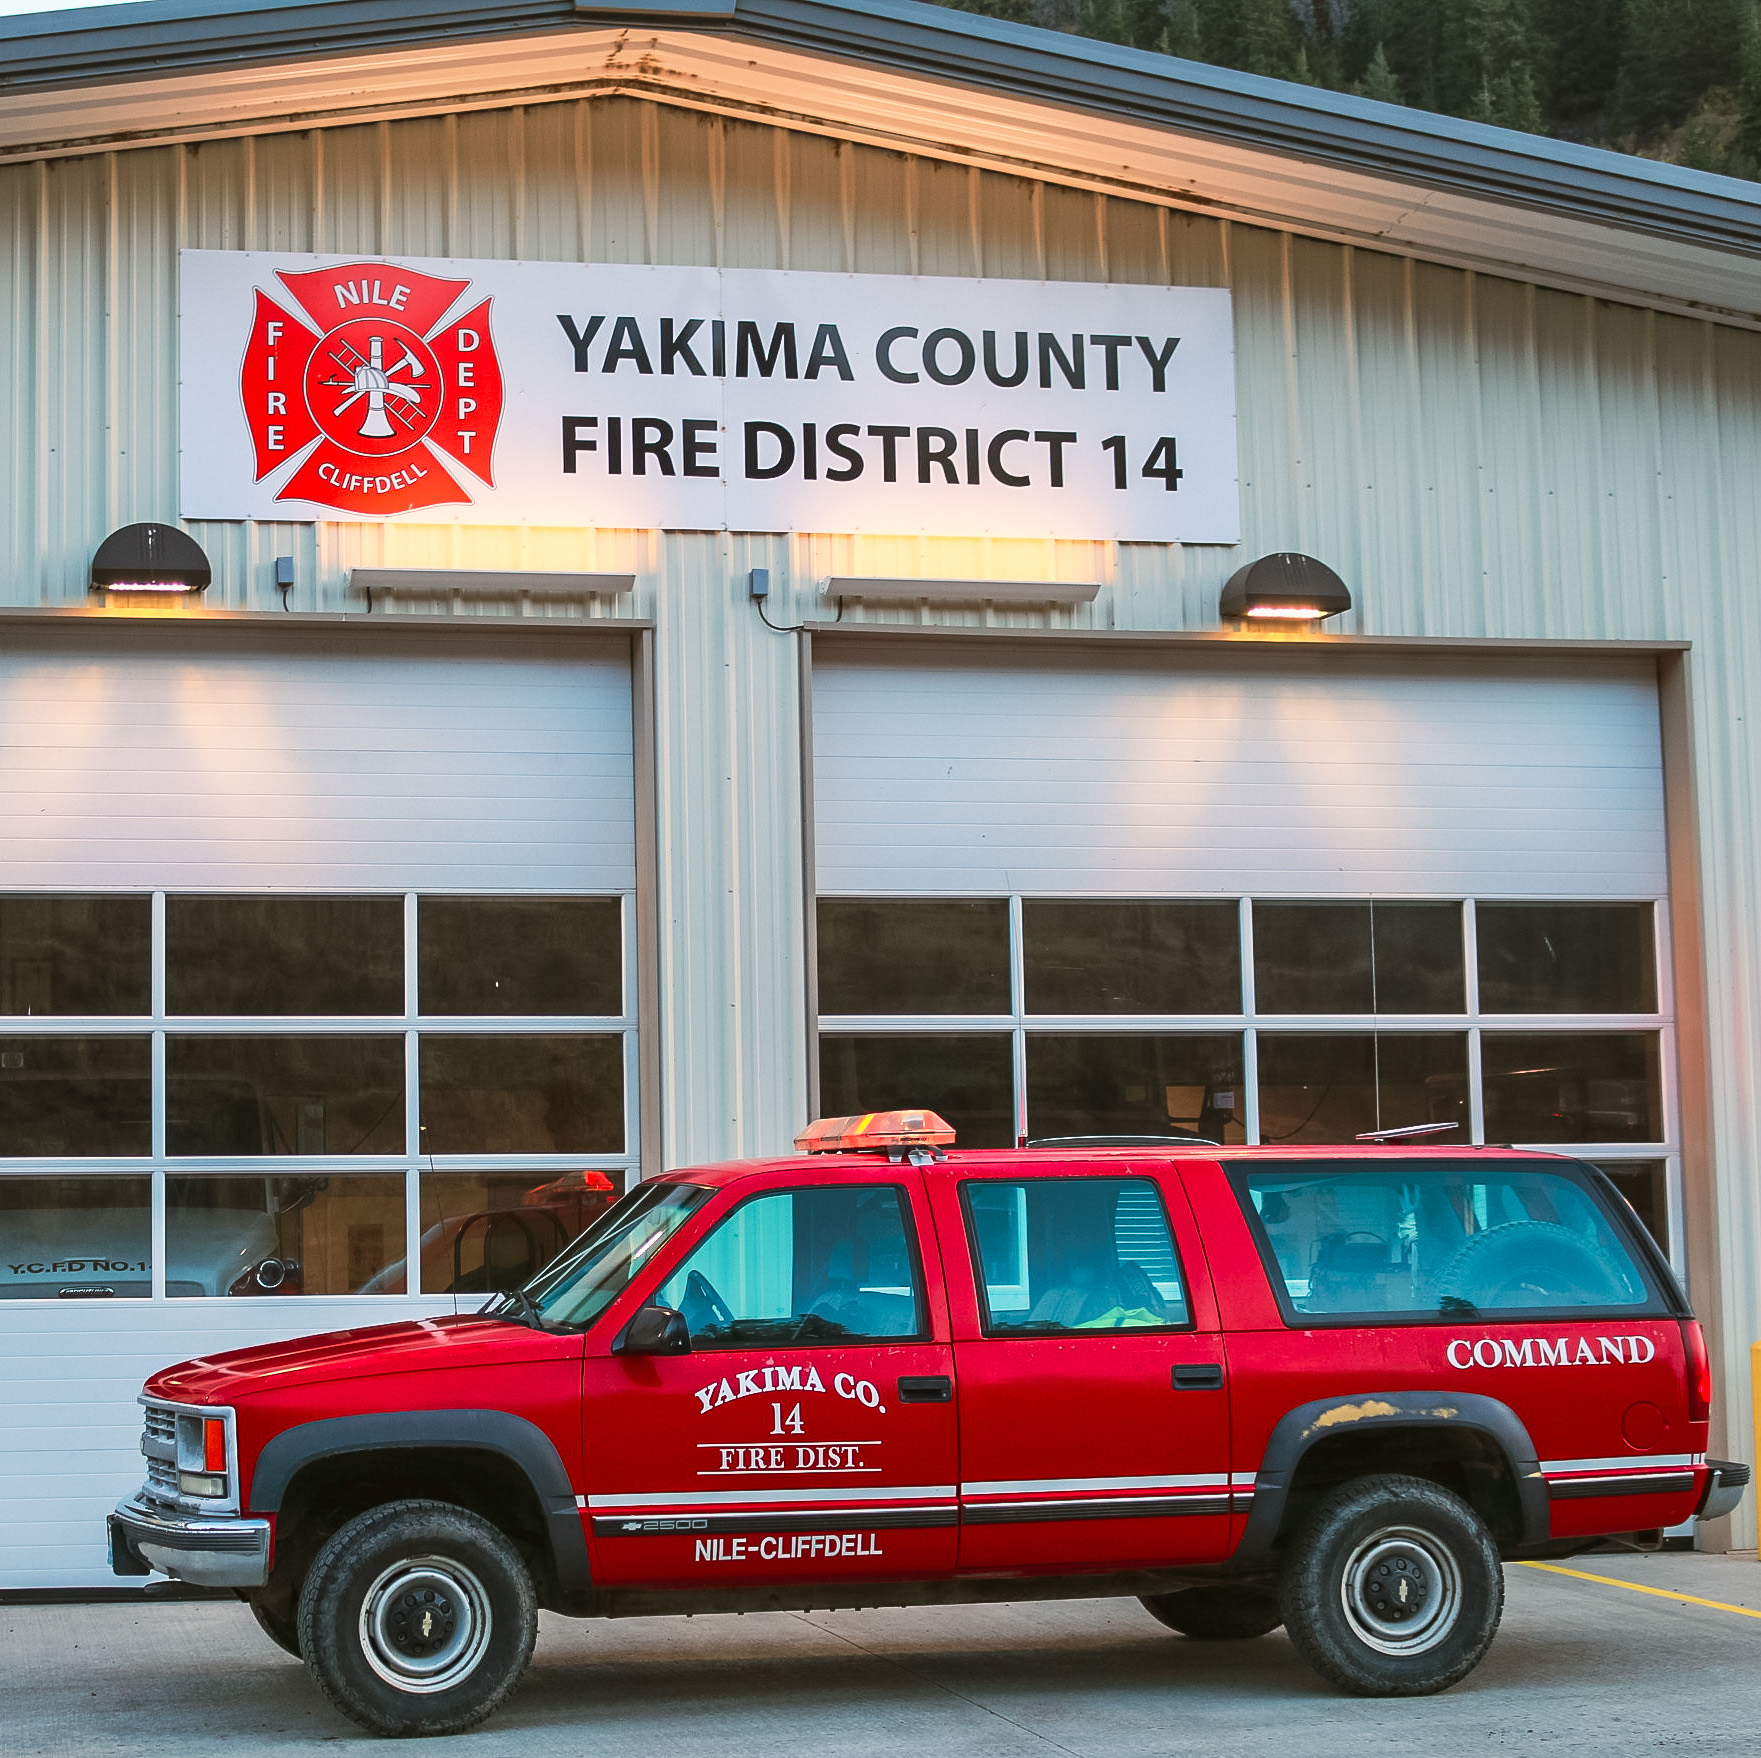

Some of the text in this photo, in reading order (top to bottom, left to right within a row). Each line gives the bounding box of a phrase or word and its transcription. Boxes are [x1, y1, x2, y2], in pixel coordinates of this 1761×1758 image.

[333, 279, 411, 311] NILE
[556, 314, 1181, 393] YAKIMA COUNTY
[266, 321, 287, 450] FIRE
[457, 328, 481, 454] DEPT
[562, 416, 1184, 492] FIRE DISTRICT 14
[317, 462, 428, 494] CLIFFDELL
[93, 1261, 152, 1272] NO.1
[1446, 1335, 1656, 1369] COMMAND
[694, 1366, 887, 1415] YAKIMA CO.
[770, 1402, 805, 1435] 14
[719, 1446, 865, 1470] FIRE DIST.
[643, 1519, 708, 1531] 2500
[694, 1533, 883, 1562] NILE-CLIFFDELL
